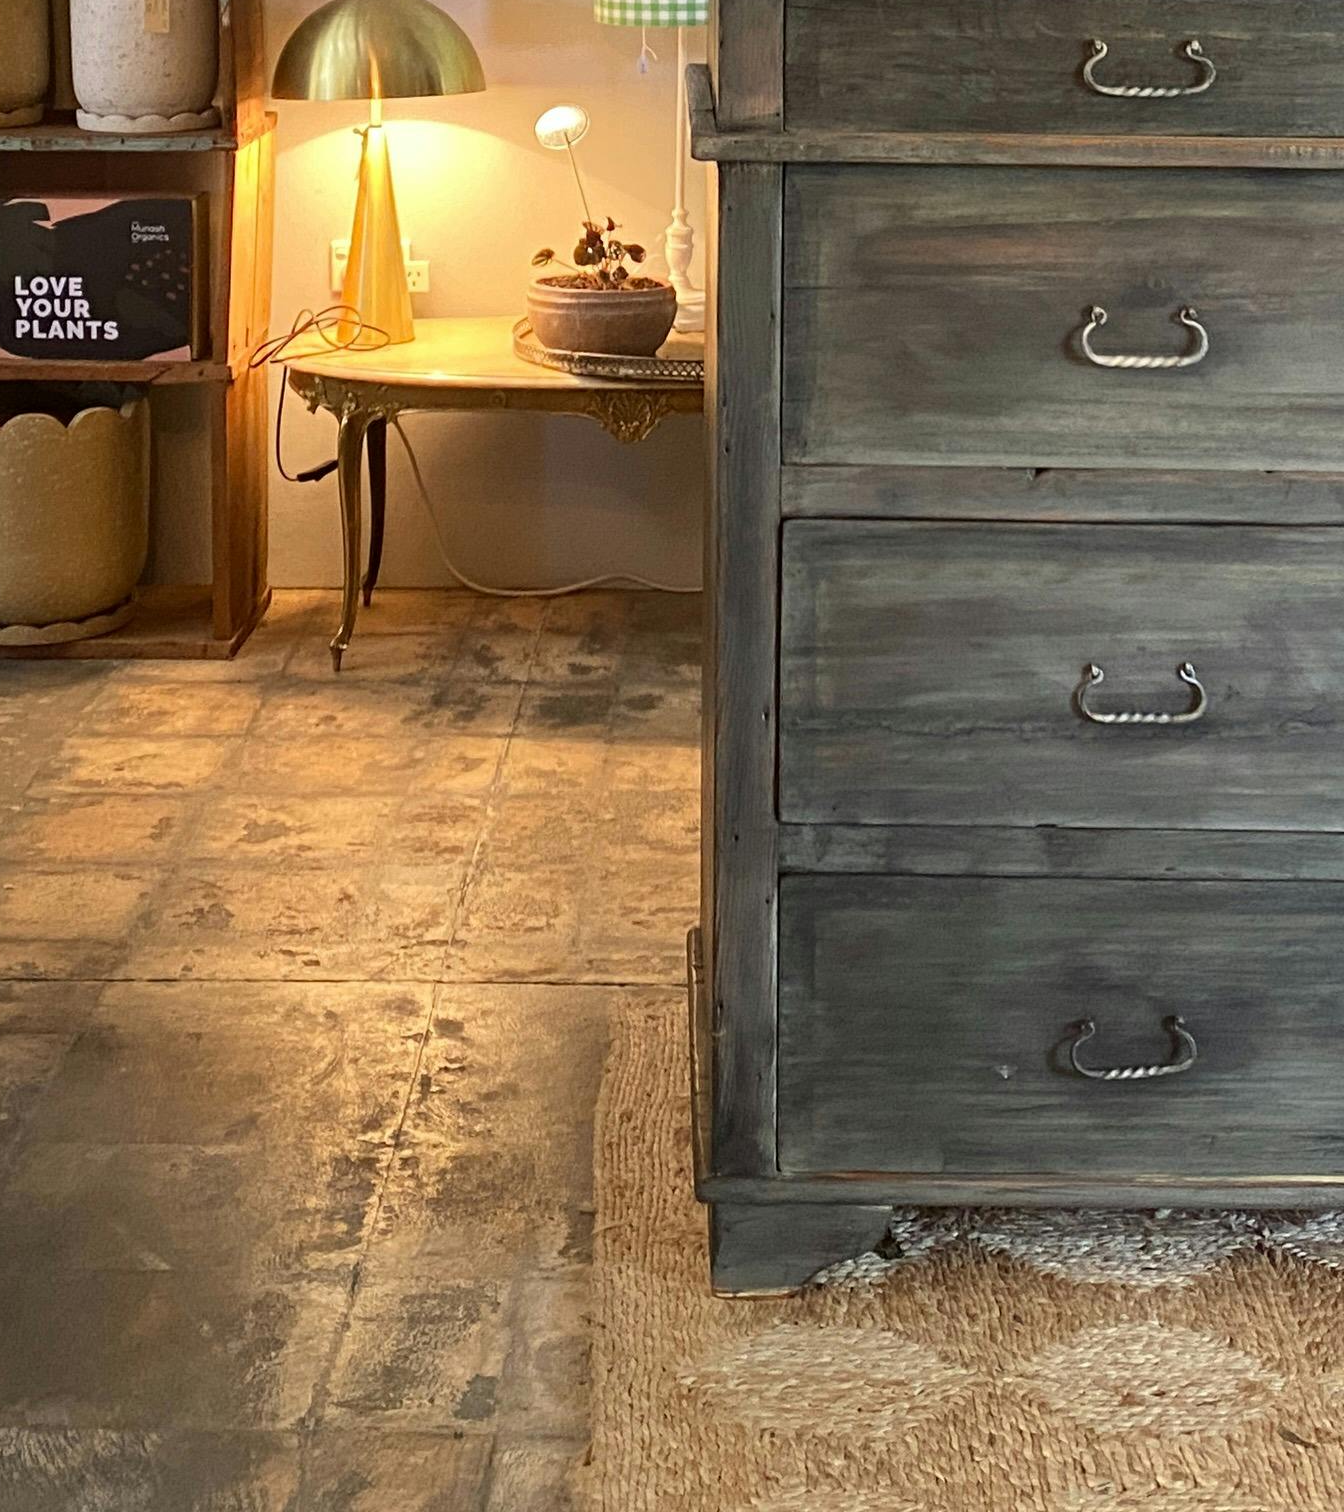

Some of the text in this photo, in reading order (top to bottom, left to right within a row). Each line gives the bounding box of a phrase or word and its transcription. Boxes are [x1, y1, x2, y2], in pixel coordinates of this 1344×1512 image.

[131, 233, 170, 243] Organics
[15, 276, 83, 297] LOVE
[16, 298, 91, 318] YOUR
[15, 320, 119, 340] PLANTS
